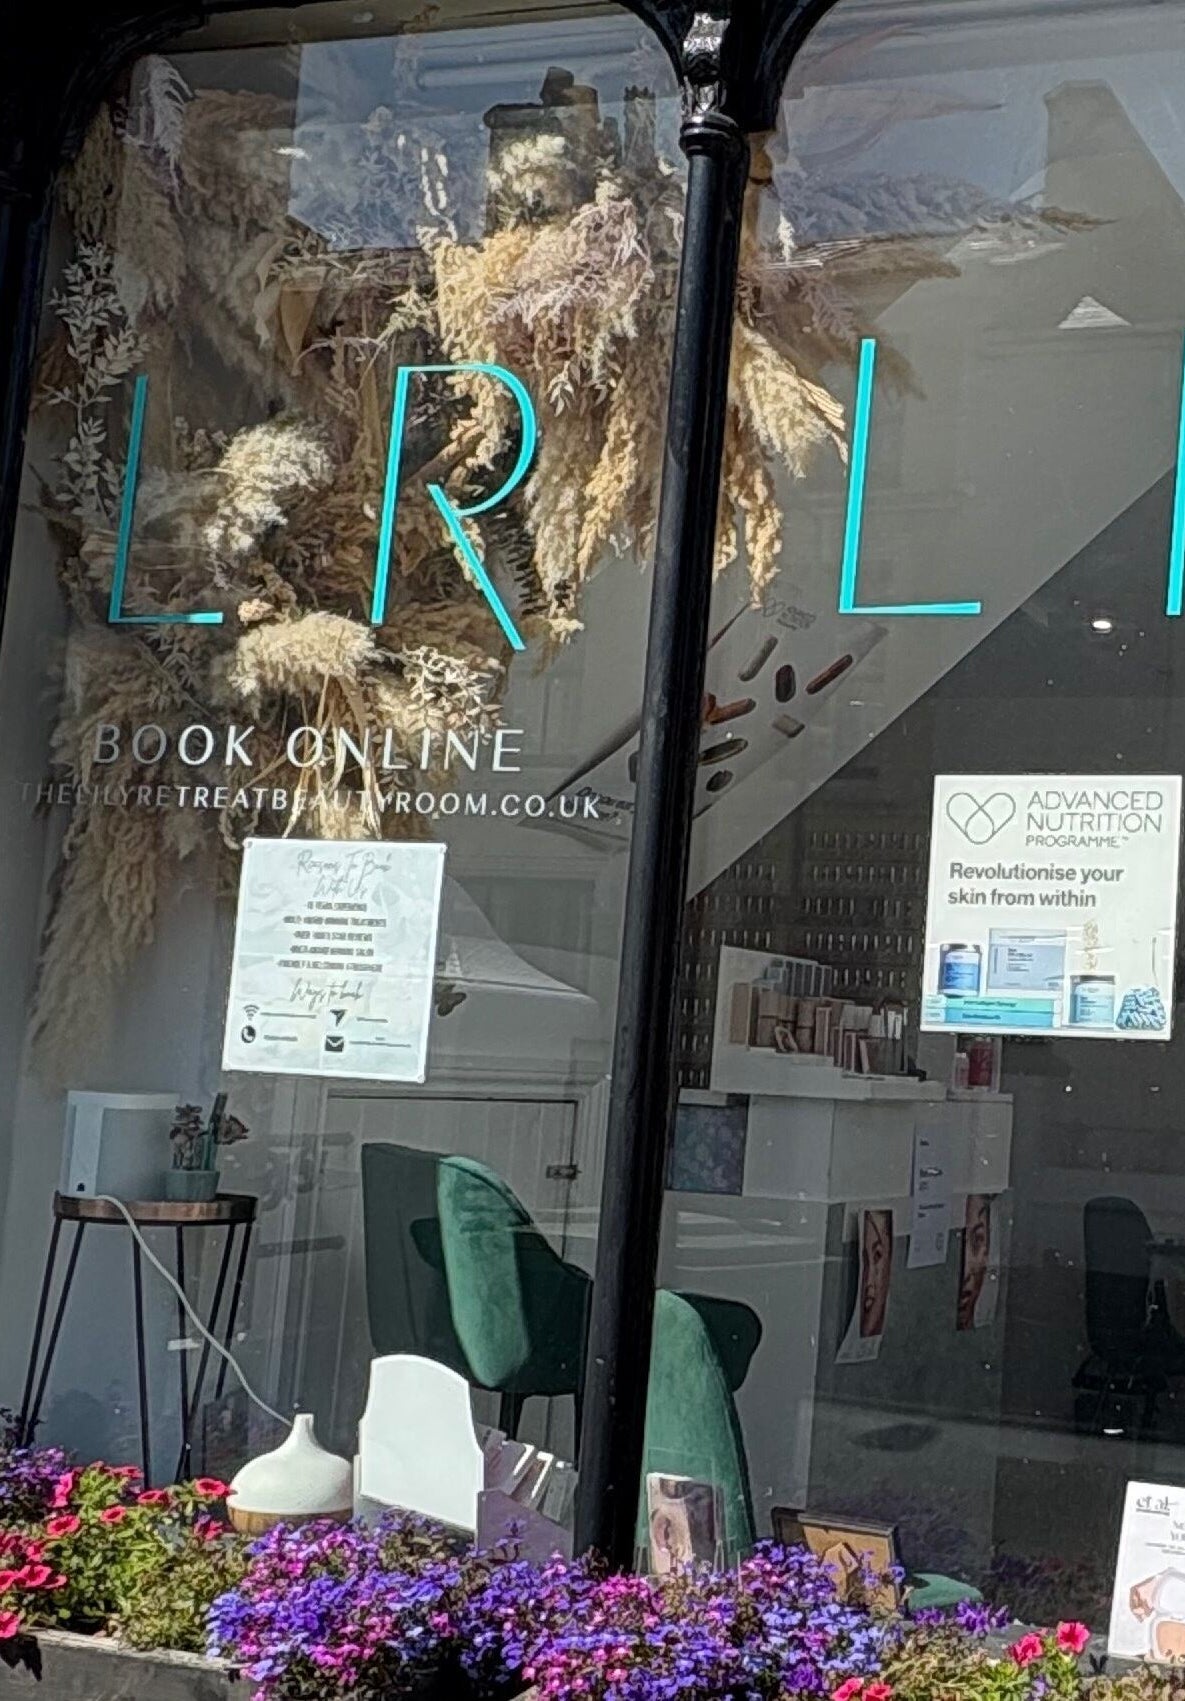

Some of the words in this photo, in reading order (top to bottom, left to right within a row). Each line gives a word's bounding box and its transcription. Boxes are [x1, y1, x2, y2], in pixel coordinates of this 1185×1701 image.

[92, 723, 256, 766] BOOK
[286, 726, 524, 772] ONLINE
[1027, 790, 1164, 811] ADVANCED
[1026, 812, 1163, 833] NUTRITION
[949, 862, 1077, 881] Revolutionise
[1080, 867, 1125, 885] your
[948, 887, 987, 906] skin
[990, 889, 1035, 906] from
[1039, 889, 1097, 908] within
